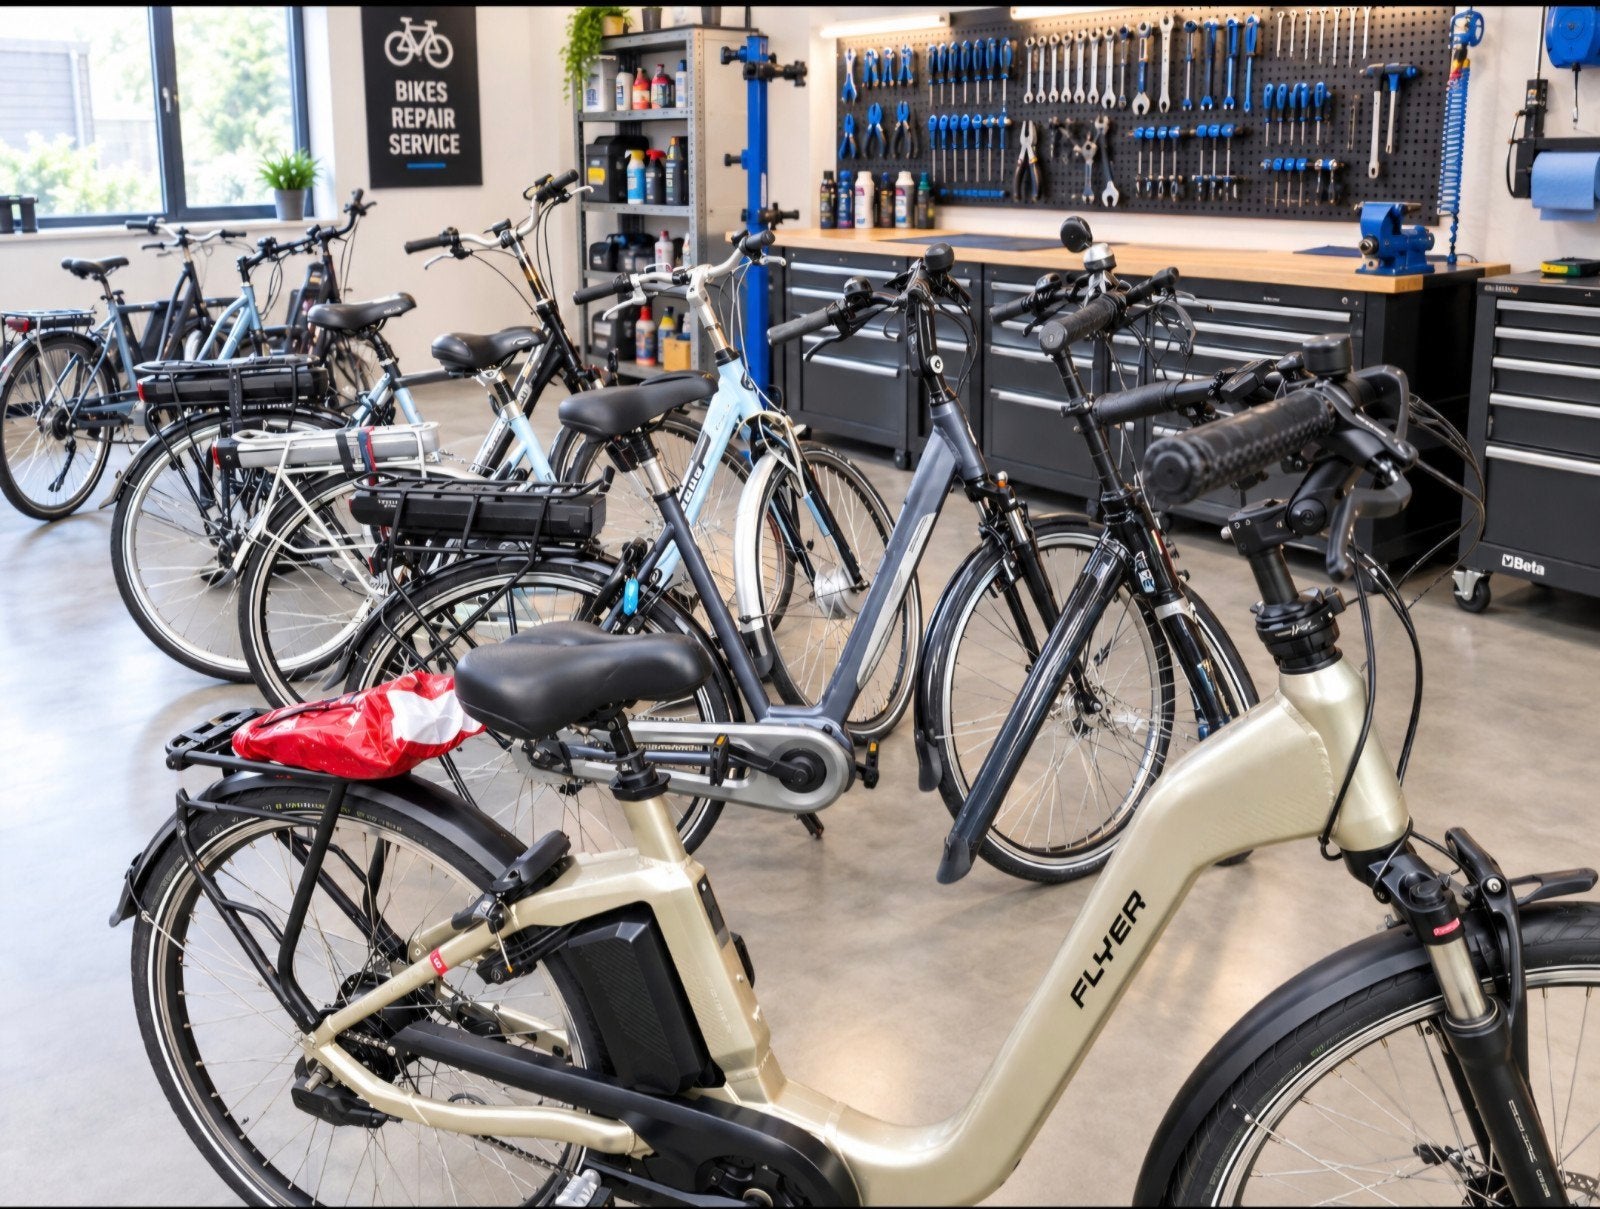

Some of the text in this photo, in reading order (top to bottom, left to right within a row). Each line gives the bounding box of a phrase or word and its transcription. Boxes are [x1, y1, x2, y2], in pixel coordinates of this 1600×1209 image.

[395, 80, 448, 103] BIKES
[391, 107, 456, 129] REPAIR
[389, 133, 460, 155] SERVICE
[1070, 889, 1147, 1010] FLYER
